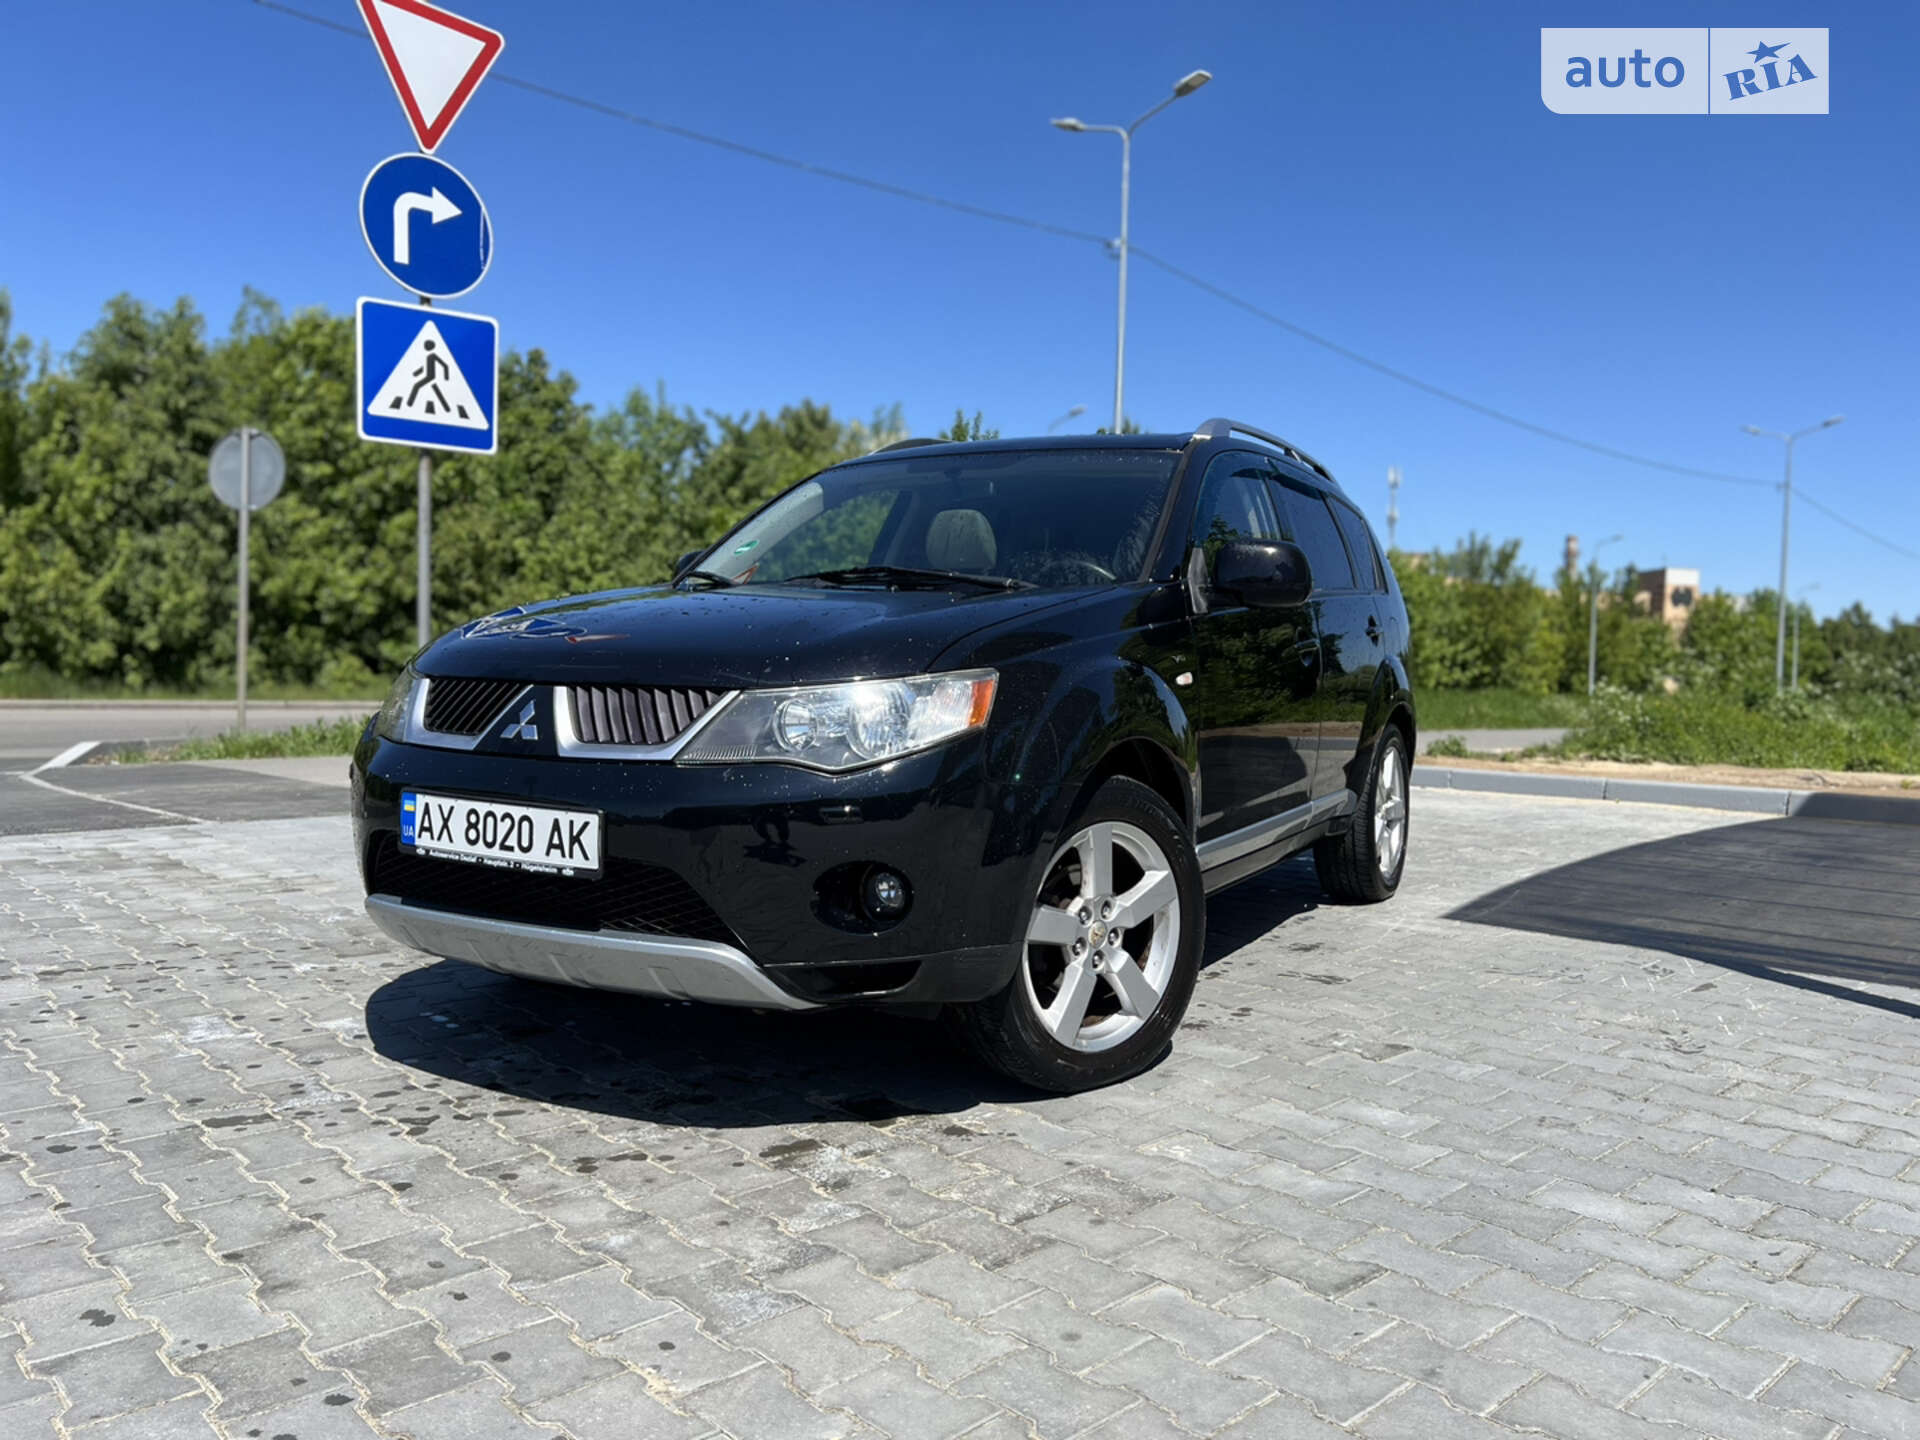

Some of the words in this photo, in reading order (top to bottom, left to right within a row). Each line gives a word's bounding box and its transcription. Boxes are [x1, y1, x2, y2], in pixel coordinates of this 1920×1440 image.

[403, 824, 415, 838] UA
[418, 802, 455, 844] AX
[465, 808, 534, 853] 8020
[545, 817, 590, 861] AK
